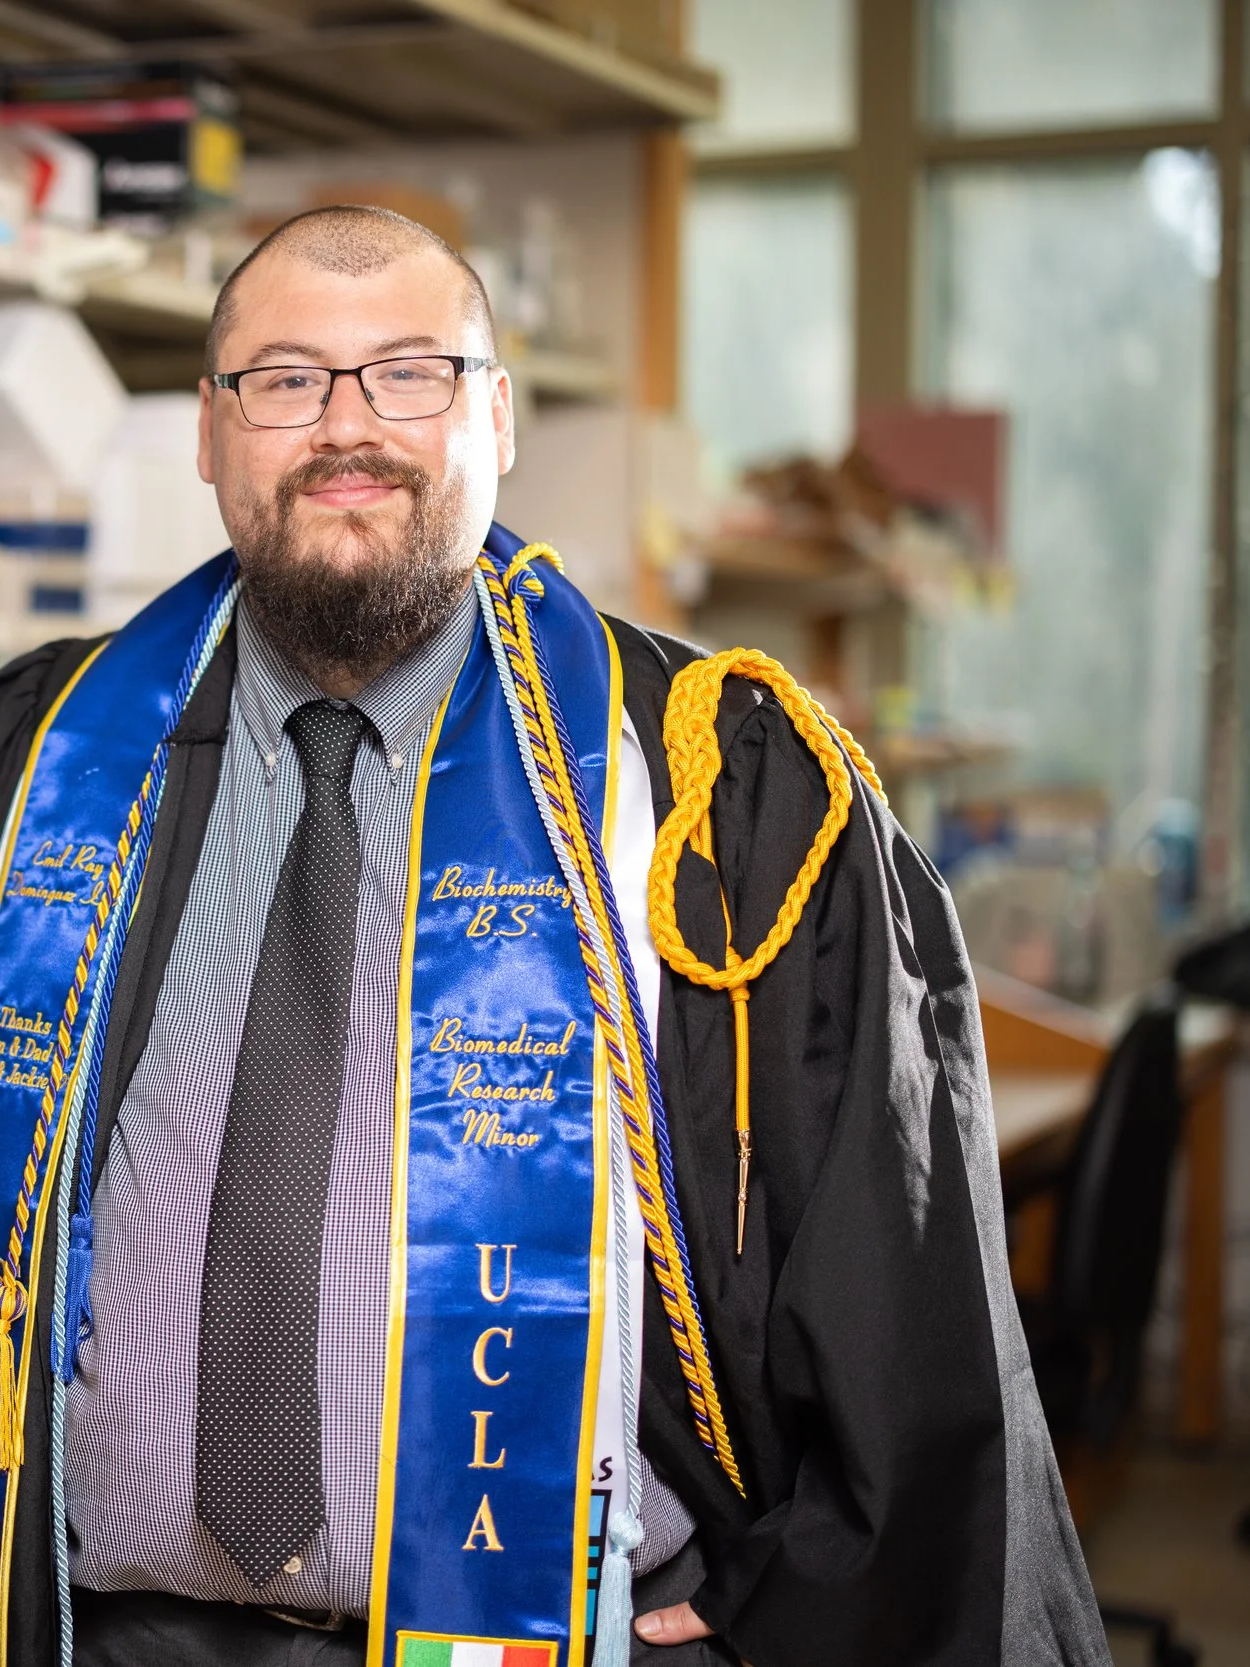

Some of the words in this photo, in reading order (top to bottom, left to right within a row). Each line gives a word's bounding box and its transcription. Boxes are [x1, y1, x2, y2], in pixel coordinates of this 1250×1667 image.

[33, 840, 74, 868] Emil
[70, 845, 105, 881] Ray
[5, 871, 78, 908] Dominguez
[432, 866, 573, 909] Biochemistry
[466, 904, 538, 939] B.S.
[9, 1036, 21, 1057] &
[20, 1037, 54, 1063] Dad
[429, 1017, 577, 1055] Biomedical
[5, 1063, 49, 1090] Jackie
[447, 1062, 556, 1102] Research
[462, 1108, 541, 1148] Minor
[462, 1243, 518, 1552] UCLA
